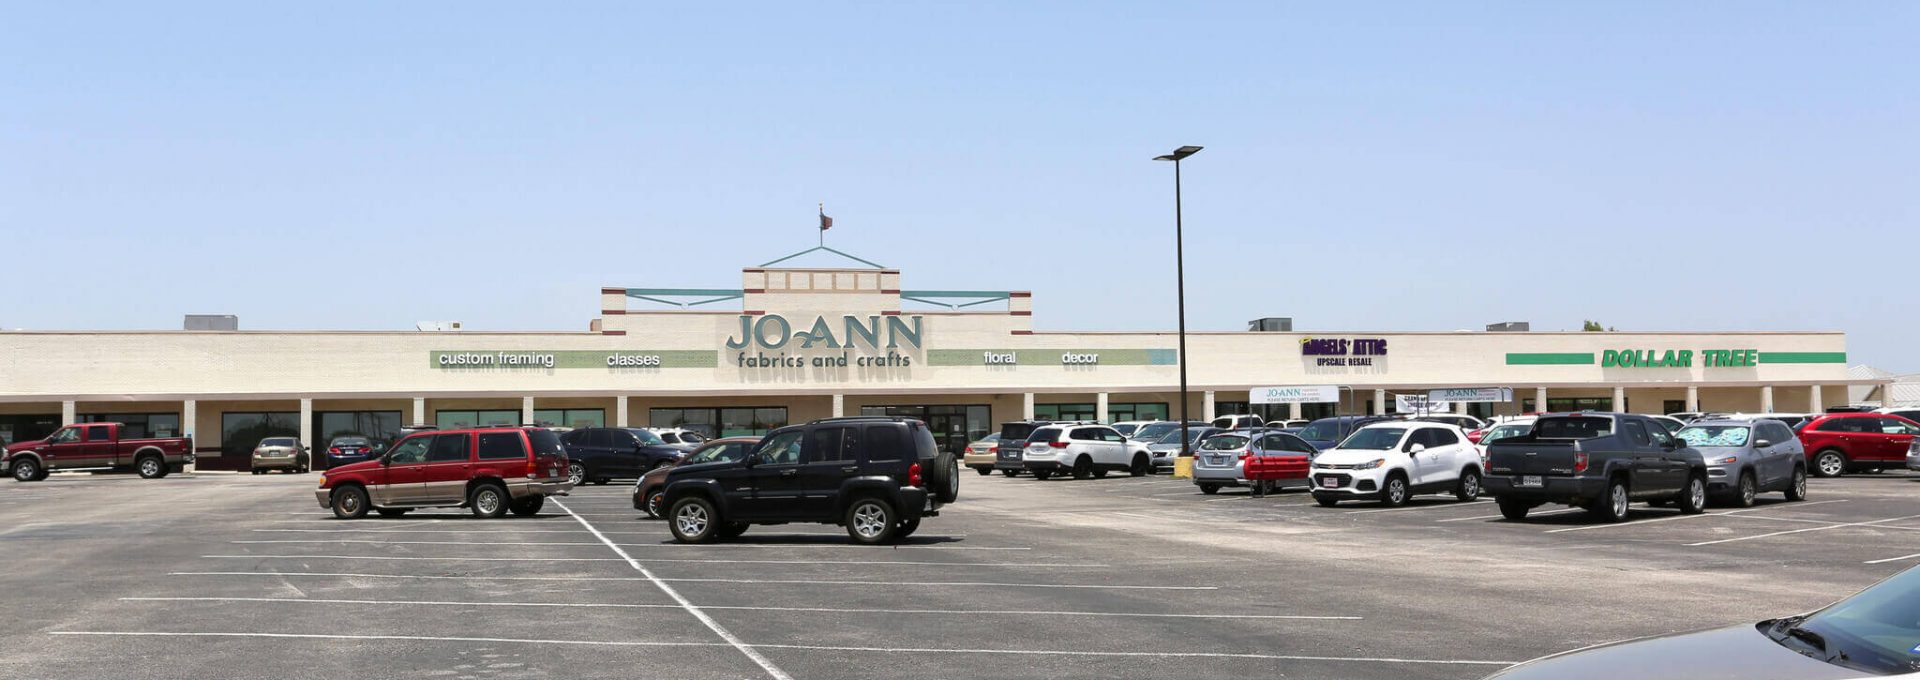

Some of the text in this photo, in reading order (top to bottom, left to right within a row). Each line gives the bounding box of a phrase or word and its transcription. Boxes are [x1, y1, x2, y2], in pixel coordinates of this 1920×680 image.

[1352, 338, 1388, 356] ATTIC
[439, 351, 555, 368] custom framing
[606, 353, 661, 366] classes
[738, 351, 911, 368] fabrics and crafts
[984, 351, 1099, 364] floral decor
[1317, 357, 1372, 367] UPSCALE RESALE
[1601, 349, 1758, 368] DOLLAR TREE
